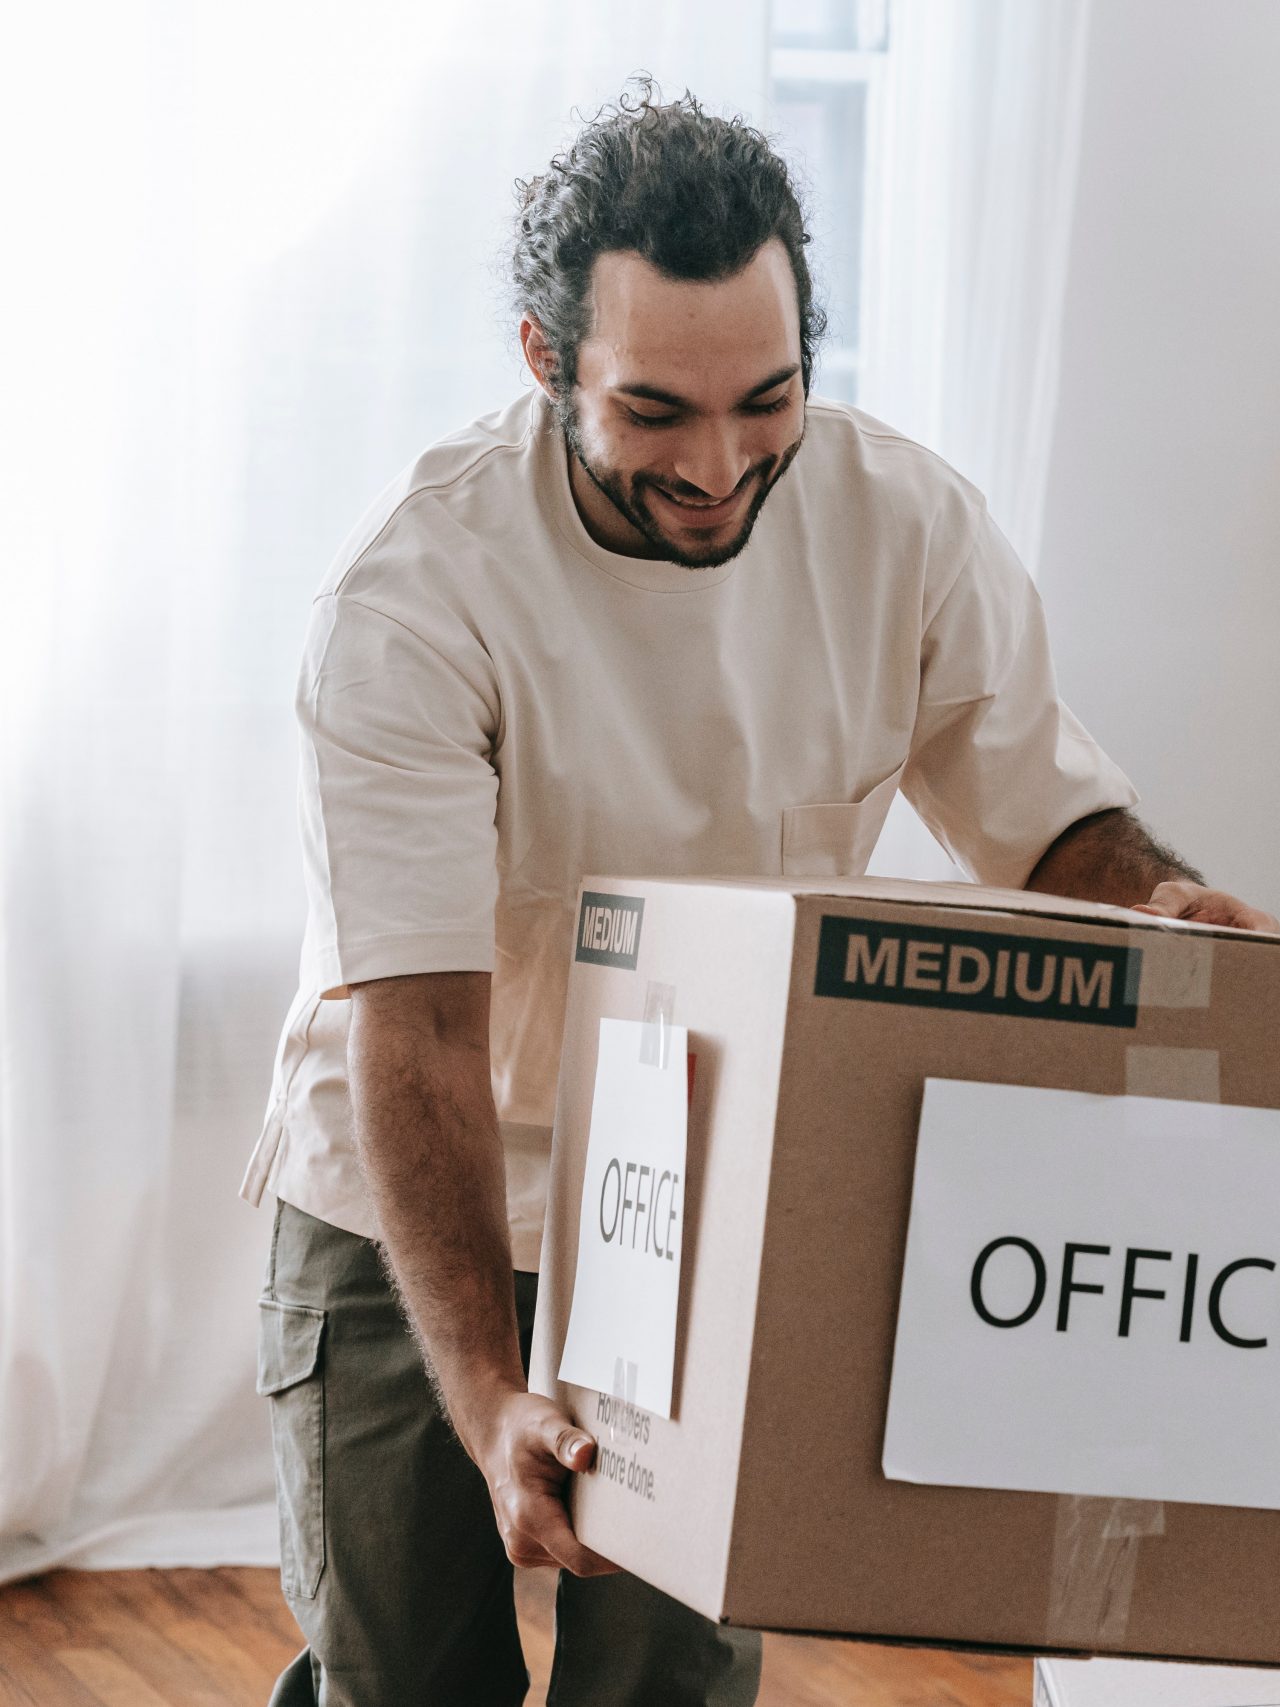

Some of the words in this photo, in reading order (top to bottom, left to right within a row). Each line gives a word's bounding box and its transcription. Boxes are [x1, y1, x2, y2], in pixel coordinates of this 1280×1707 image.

[582, 906, 638, 955] MEDIUM
[845, 934, 1114, 1009] MEDIUM
[600, 1158, 679, 1261] OFFICE
[599, 1447, 626, 1485] more
[628, 1452, 655, 1502] done.
